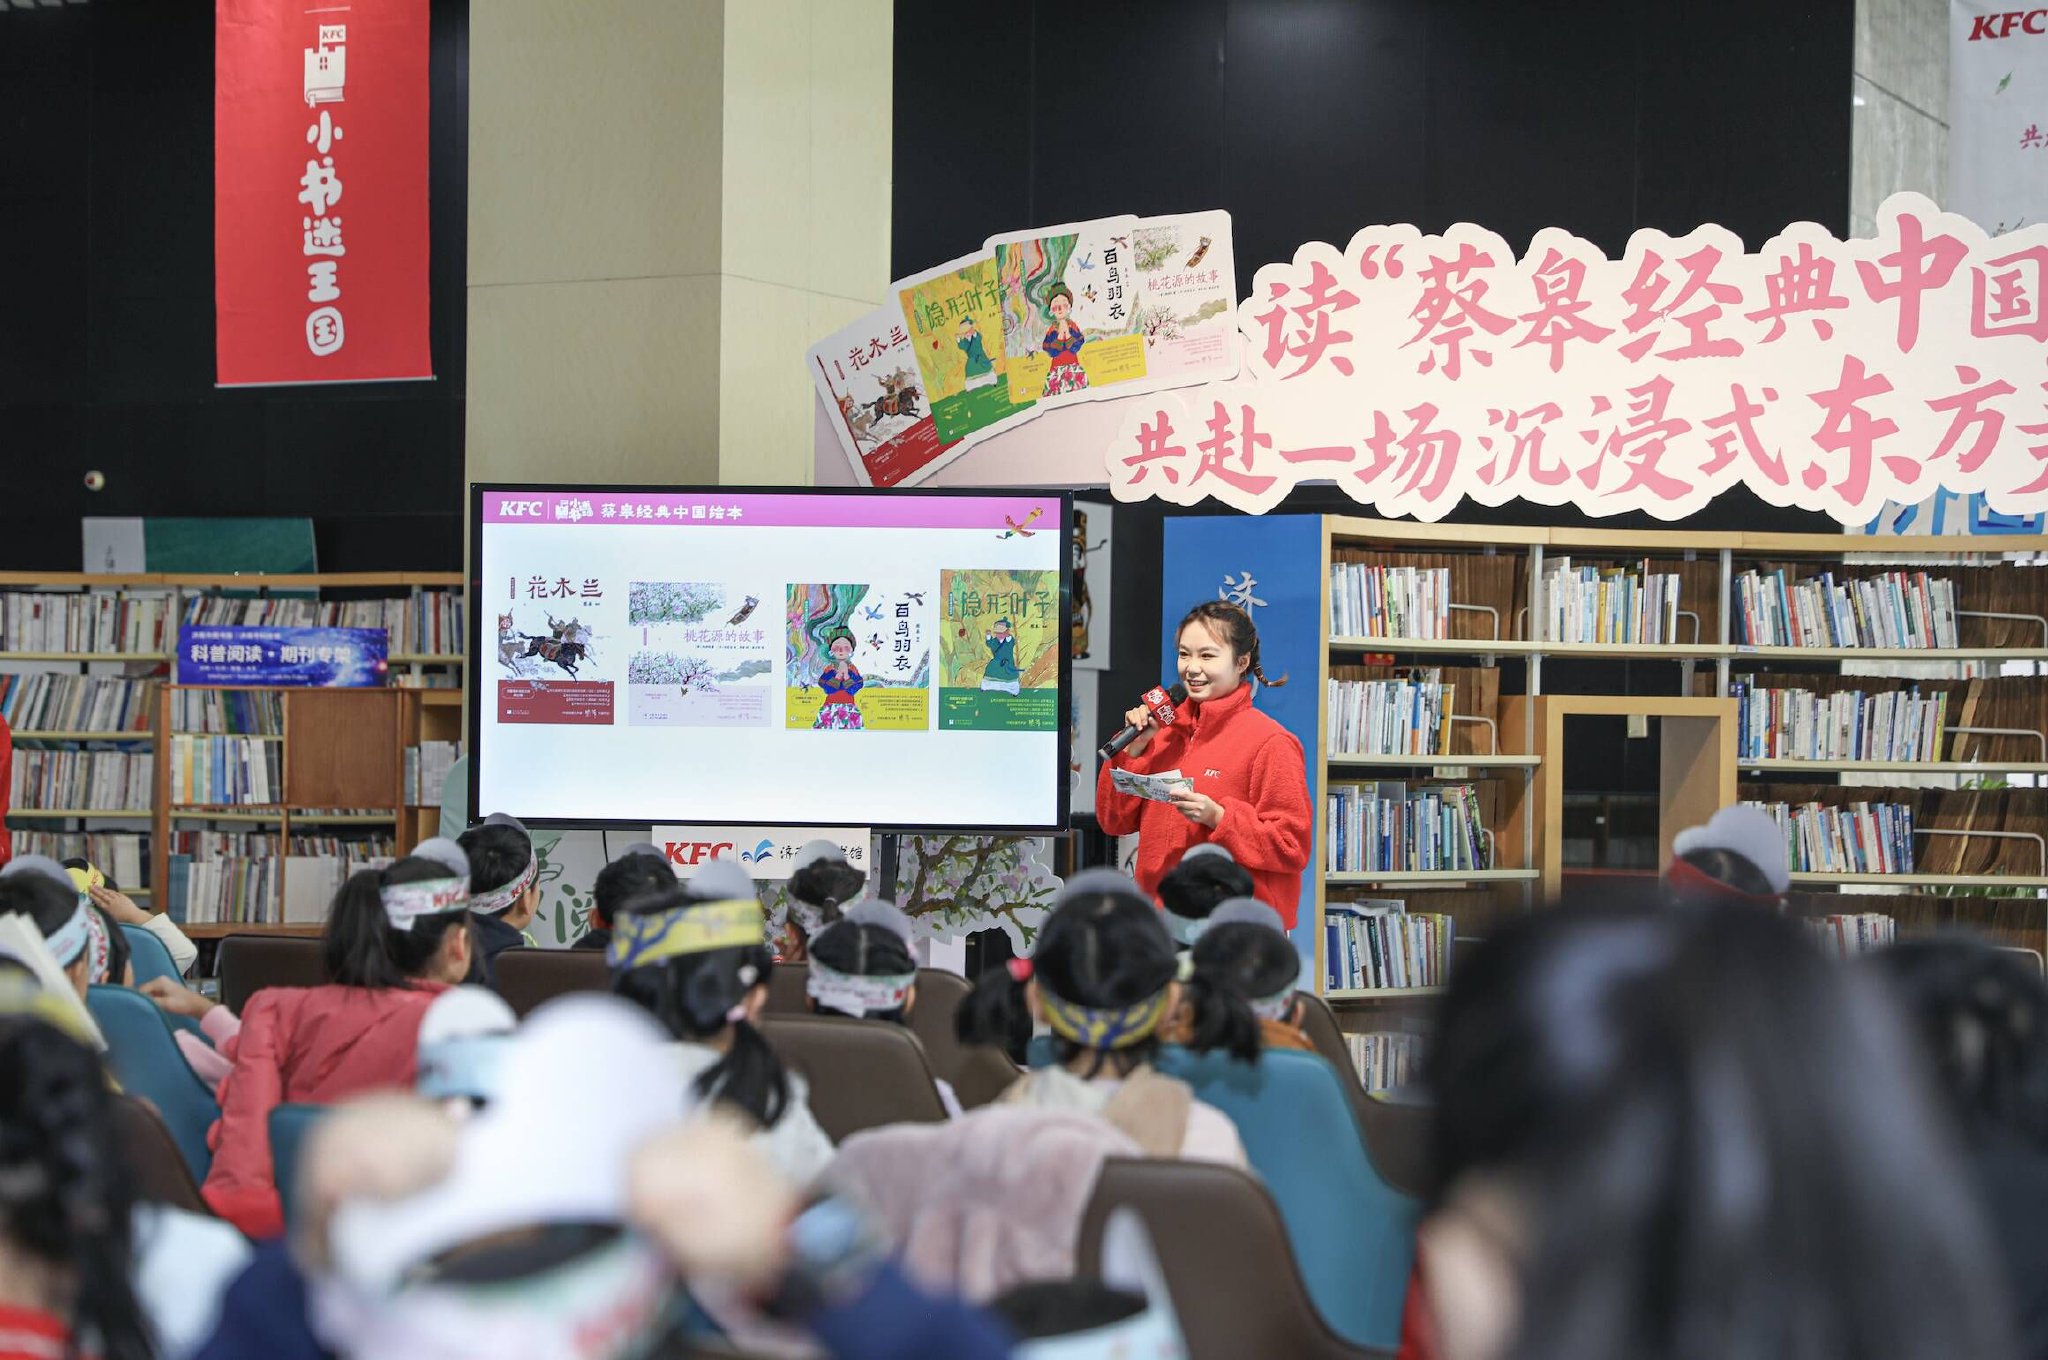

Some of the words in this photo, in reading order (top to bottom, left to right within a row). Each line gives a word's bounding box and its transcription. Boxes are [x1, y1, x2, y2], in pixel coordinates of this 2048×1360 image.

[322, 29, 344, 40] KFC
[1968, 9, 2048, 41] KFC
[2019, 123, 2048, 150] 共
[298, 110, 346, 356] 小书迷王国
[1103, 247, 1126, 321] 百鸟羽衣
[1147, 268, 1221, 292] 桃花源的故事
[924, 279, 1000, 331] 隐形叶子
[848, 325, 908, 371] 花木兰
[499, 500, 544, 517] KFC
[600, 502, 744, 521] 蔡皋经典中国绘本
[526, 575, 604, 600] 花木兰
[962, 591, 1051, 619] 隐形叶子
[684, 628, 765, 644] 桃花源的故事
[893, 602, 912, 671] 百鸟羽衣
